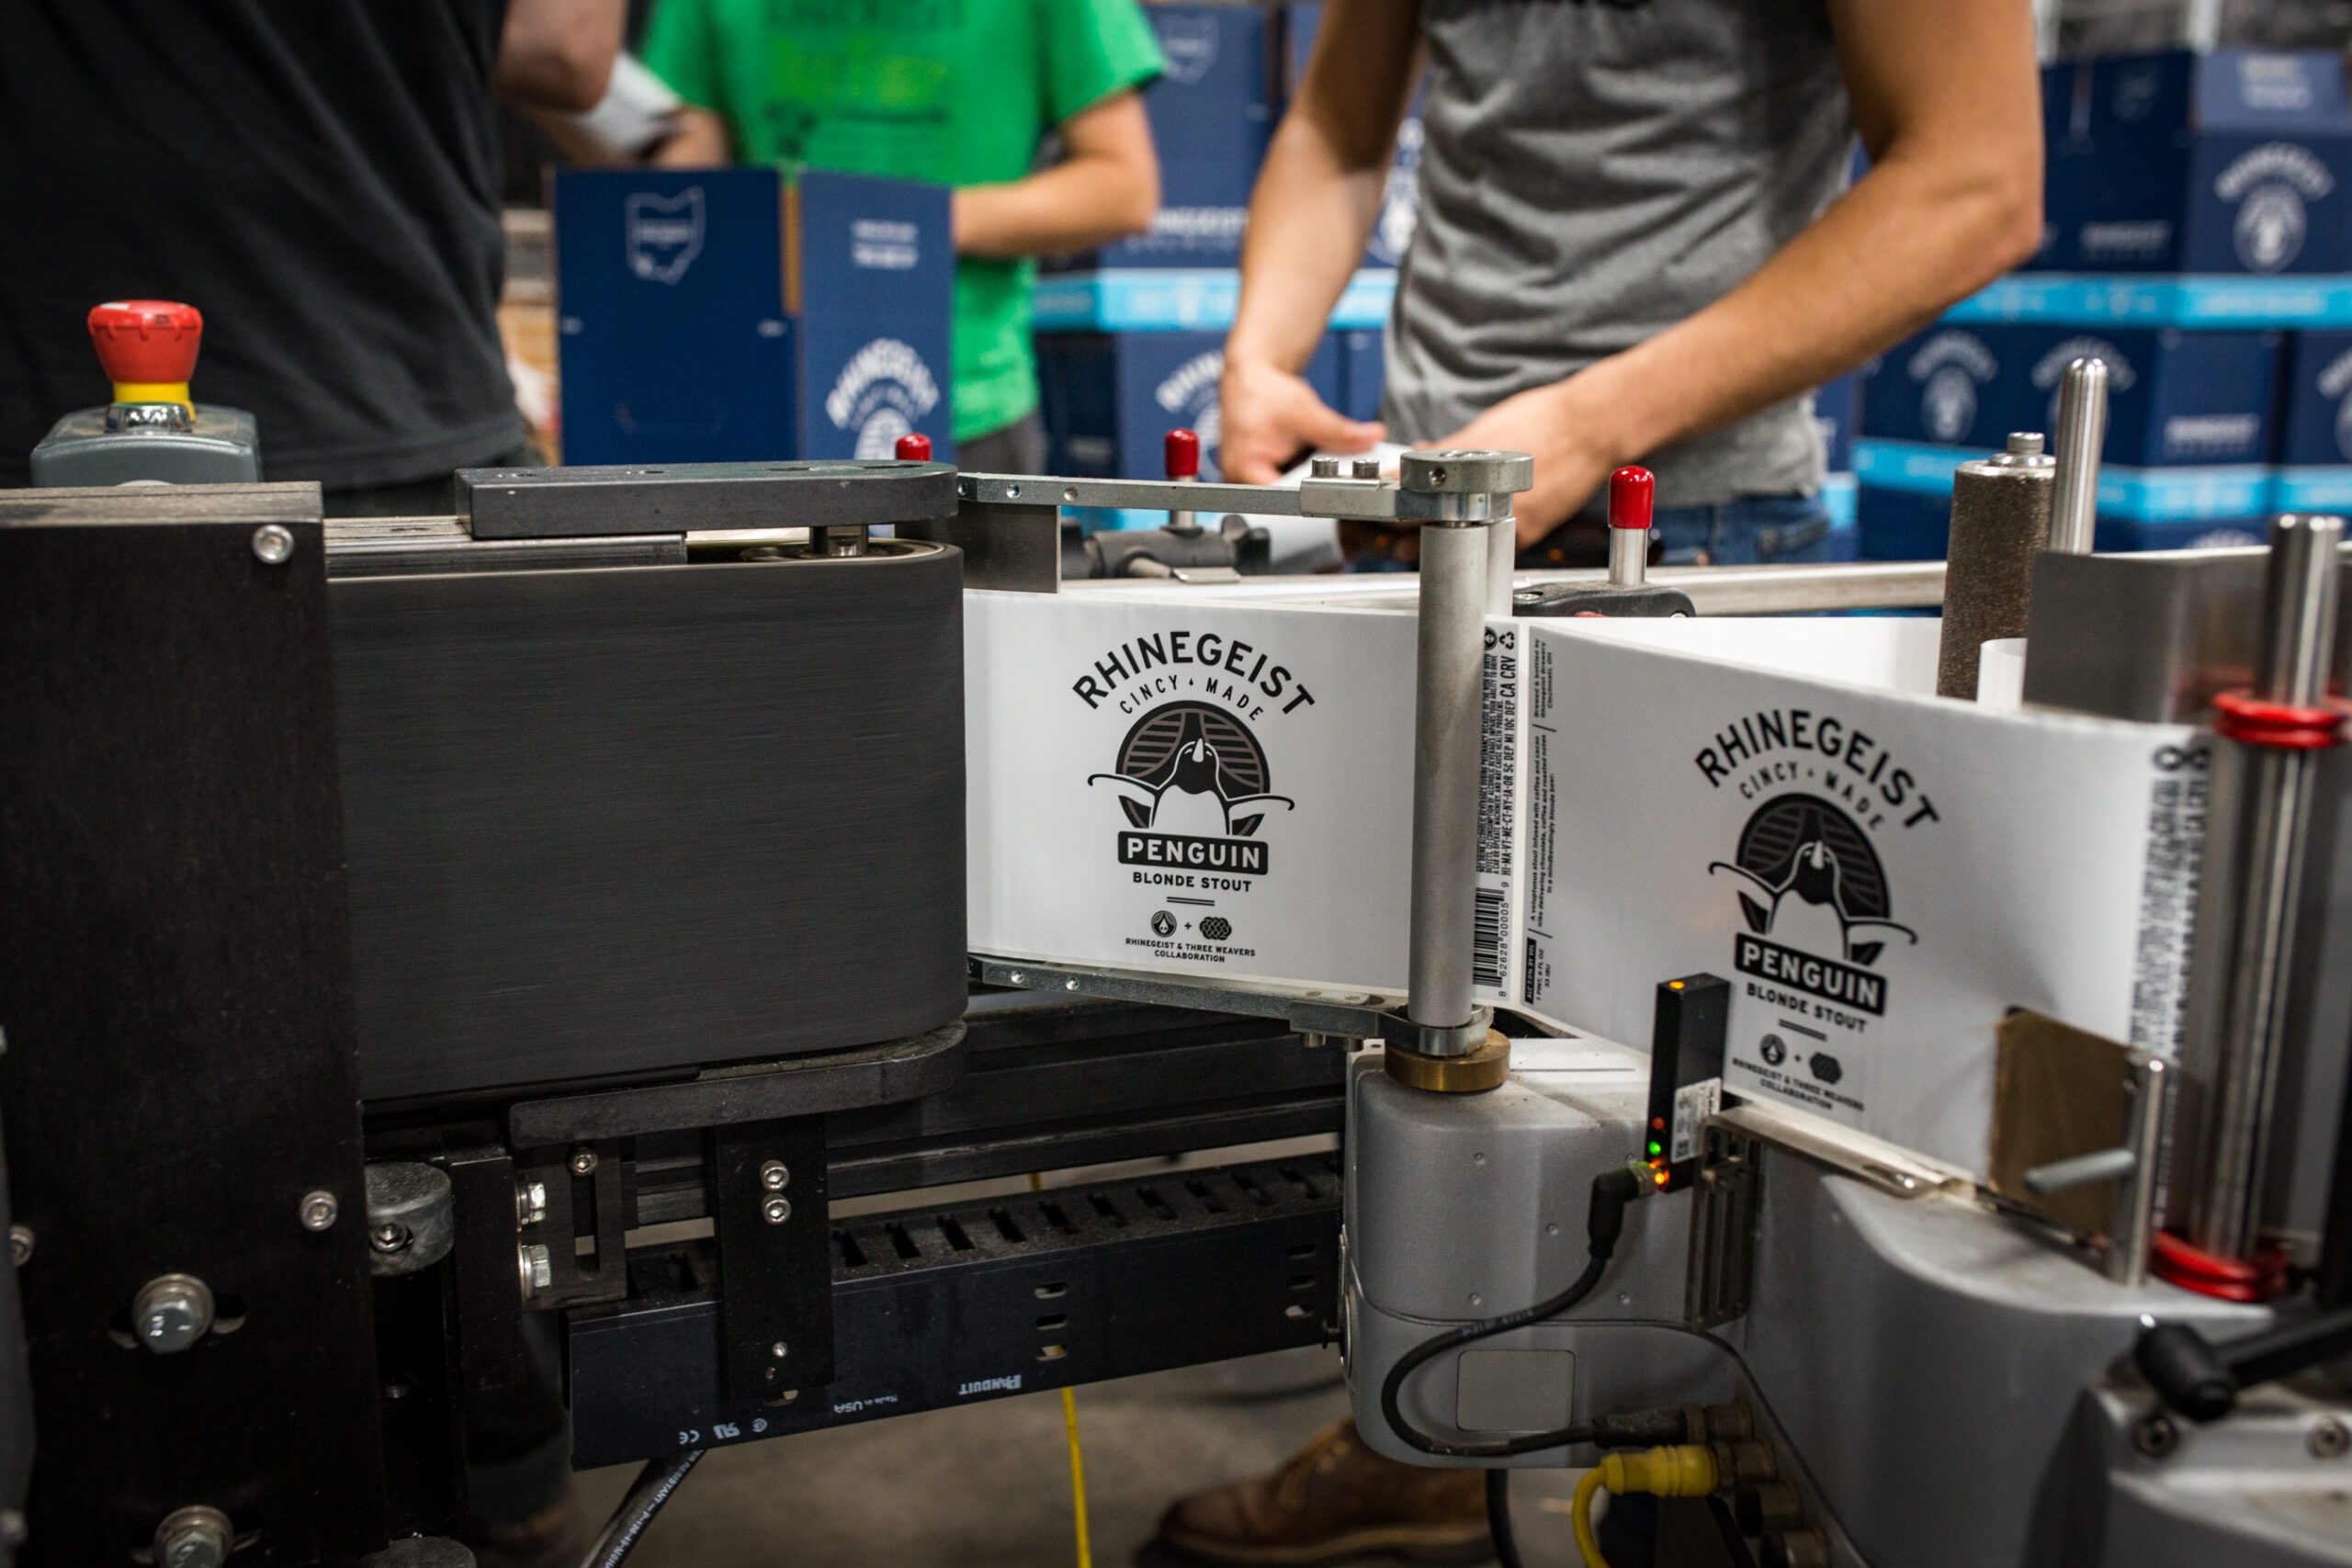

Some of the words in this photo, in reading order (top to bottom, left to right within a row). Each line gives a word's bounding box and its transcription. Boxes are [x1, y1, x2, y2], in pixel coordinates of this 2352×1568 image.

[1072, 631, 1316, 716] RHINEGEIST
[1500, 656, 1515, 678] CRV
[1120, 674, 1179, 715] CINCY
[1205, 677, 1265, 721] MADE
[1499, 683, 1515, 697] CA
[1505, 700, 1514, 715] DEP
[1504, 734, 1514, 742] MI
[1504, 745, 1513, 760] DEP
[1695, 709, 1940, 829] RHINEGEIST
[1739, 761, 1800, 800] CINCY
[1825, 773, 1885, 829] MADE
[1501, 775, 1513, 875] HI-MA-VT-ME-CT-NY-IA-OR
[1126, 836, 1261, 870] PENGUIN
[1133, 872, 1195, 888] BLONDE
[1201, 876, 1252, 893] STOUT
[1500, 902, 1509, 937] 00005
[1125, 937, 1175, 951] RHINEGEIST
[1176, 942, 1184, 951] &
[1185, 942, 1214, 953] THREE
[1215, 946, 1256, 957] WEAVERS
[1154, 950, 1226, 963] COLLABORATION
[1743, 941, 1881, 1010] PENGUIN
[1747, 982, 1808, 1015] BLONDE
[1815, 1005, 1868, 1034] STOUT
[958, 1374, 1022, 1395] PANDUIT
[833, 1400, 864, 1414] USA
